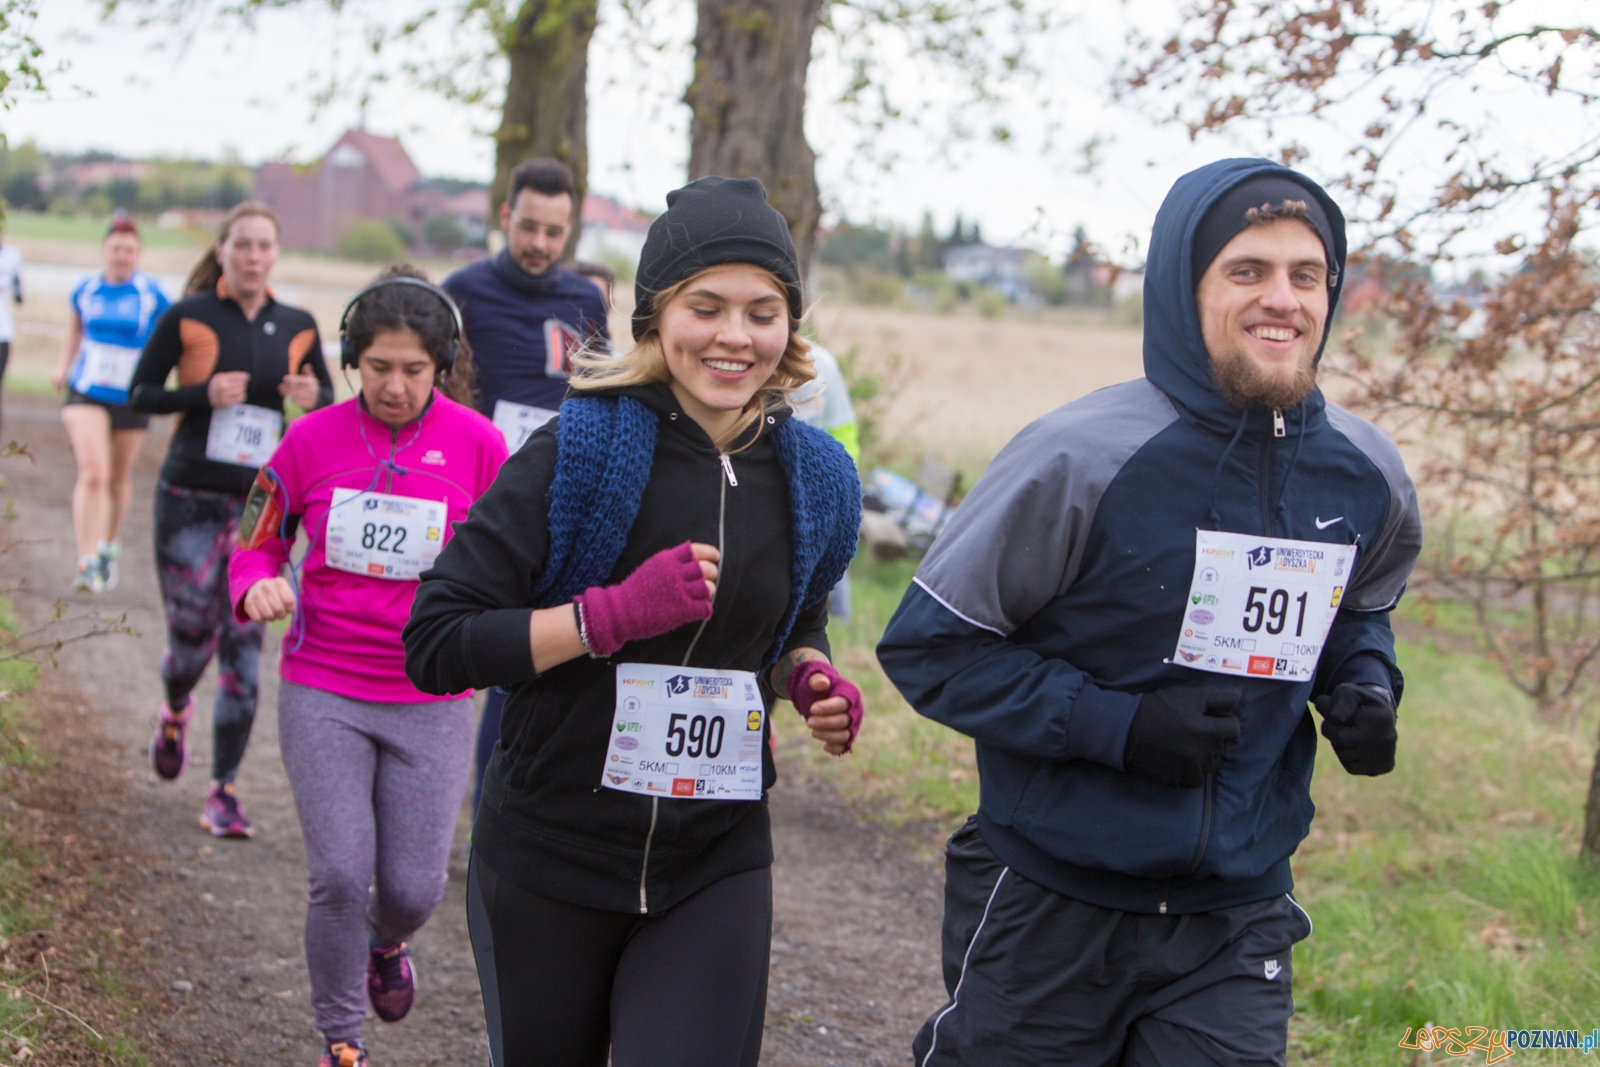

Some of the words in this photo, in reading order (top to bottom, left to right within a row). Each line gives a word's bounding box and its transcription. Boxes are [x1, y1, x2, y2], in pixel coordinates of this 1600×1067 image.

[235, 423, 261, 446] 708
[362, 522, 406, 554] 822
[1274, 555, 1307, 569] ZADYSZKA
[1276, 546, 1324, 560] UNIWERSYTECKA
[1243, 586, 1308, 638] 591
[1214, 636, 1242, 650] 5KM
[1295, 644, 1318, 656] 10KM
[666, 713, 726, 759] 590
[638, 760, 666, 773] 5KM
[710, 764, 736, 776] 10KM
